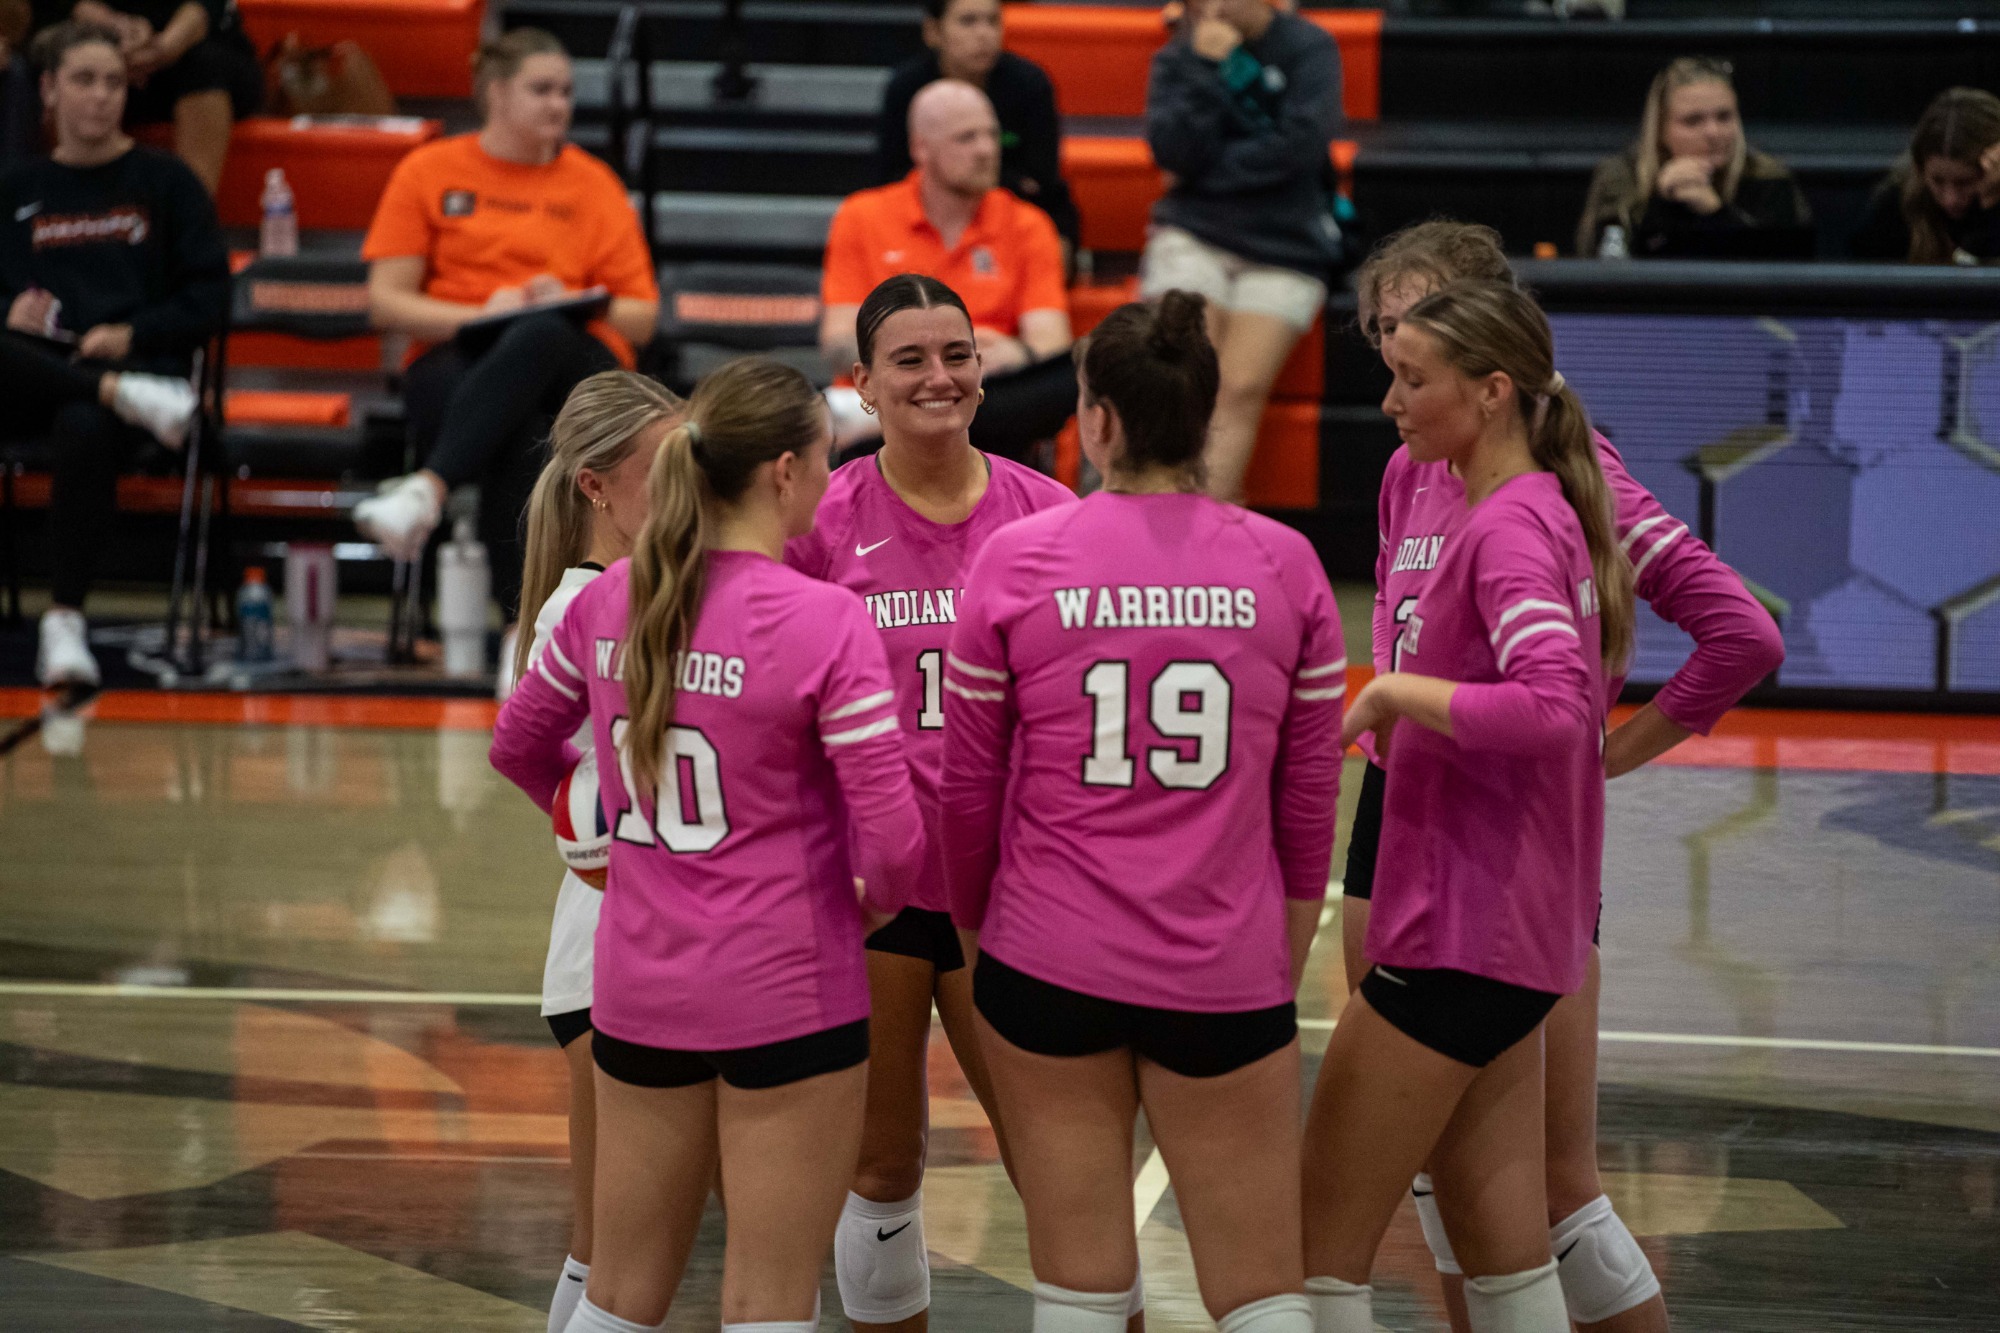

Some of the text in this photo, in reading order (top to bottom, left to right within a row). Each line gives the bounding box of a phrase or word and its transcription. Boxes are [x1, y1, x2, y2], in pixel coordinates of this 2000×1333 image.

[865, 588, 965, 629] INDIAN
[1053, 585, 1257, 630] WARRIORS
[594, 638, 745, 698] WIORS
[1082, 659, 1233, 789] 19
[610, 714, 730, 854] 10
